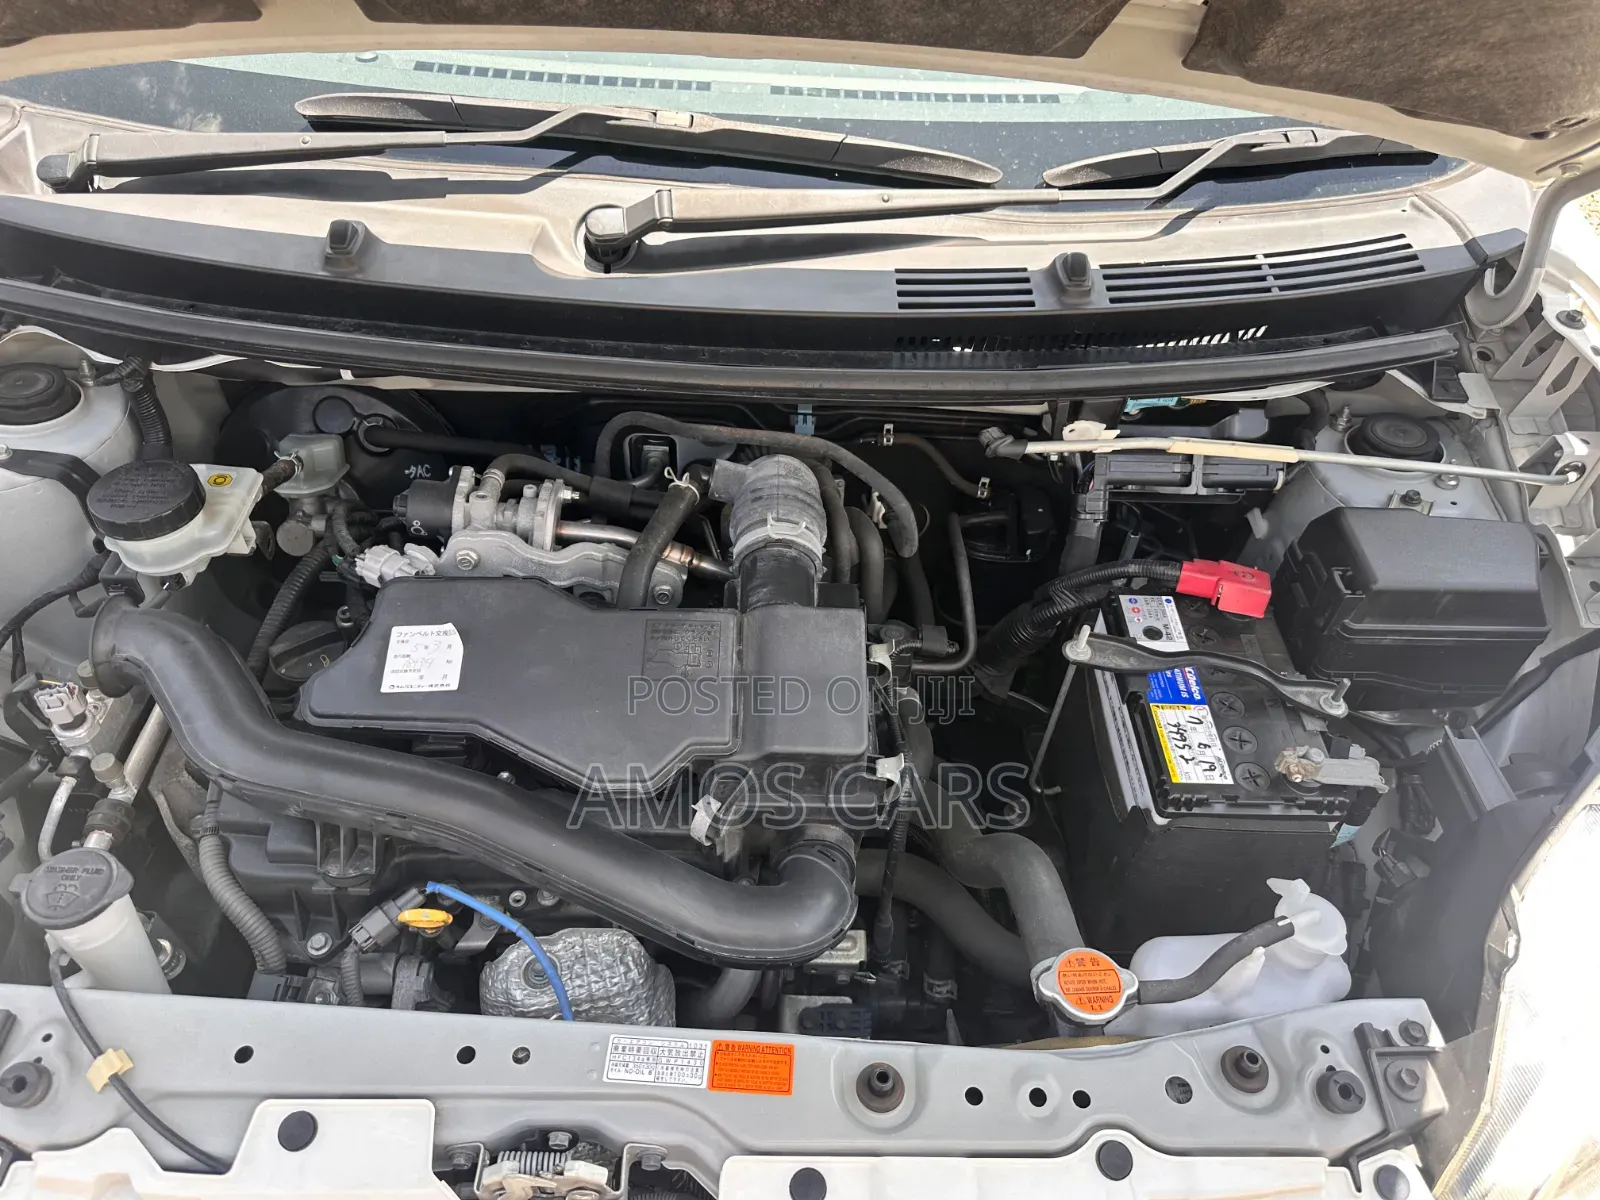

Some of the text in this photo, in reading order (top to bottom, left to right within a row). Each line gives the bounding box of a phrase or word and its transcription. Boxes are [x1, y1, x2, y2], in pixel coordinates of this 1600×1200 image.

[1161, 624, 1173, 640] M-42
[1173, 668, 1186, 690] ATINUM
[1184, 667, 1202, 699] CDelco
[1076, 957, 1100, 967] 警告
[659, 1049, 704, 1058] 大気放出禁止
[738, 1044, 762, 1053] WARNING
[762, 1046, 791, 1055] ATTENTION
